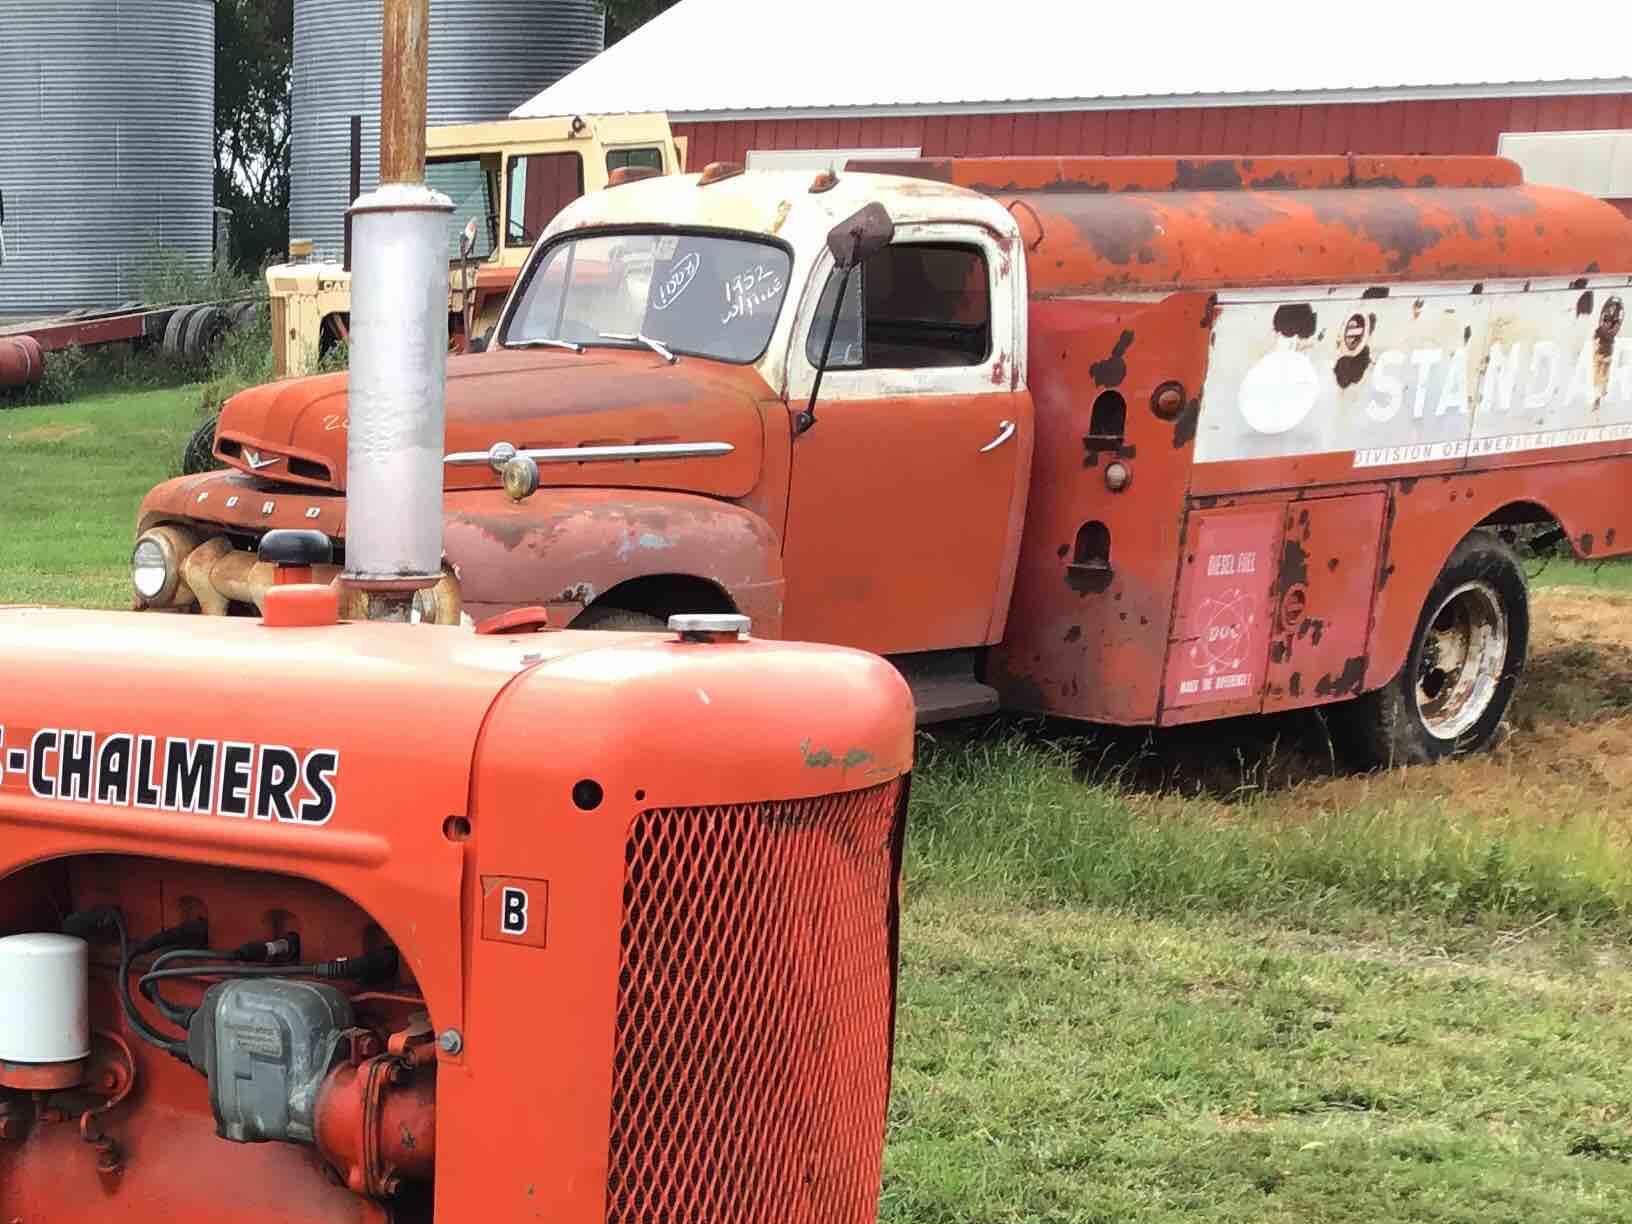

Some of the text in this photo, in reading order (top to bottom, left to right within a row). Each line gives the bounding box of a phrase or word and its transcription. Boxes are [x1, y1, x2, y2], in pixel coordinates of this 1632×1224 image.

[725, 264, 773, 302] 1952
[1442, 440, 1463, 457] OF
[500, 886, 528, 935] B
